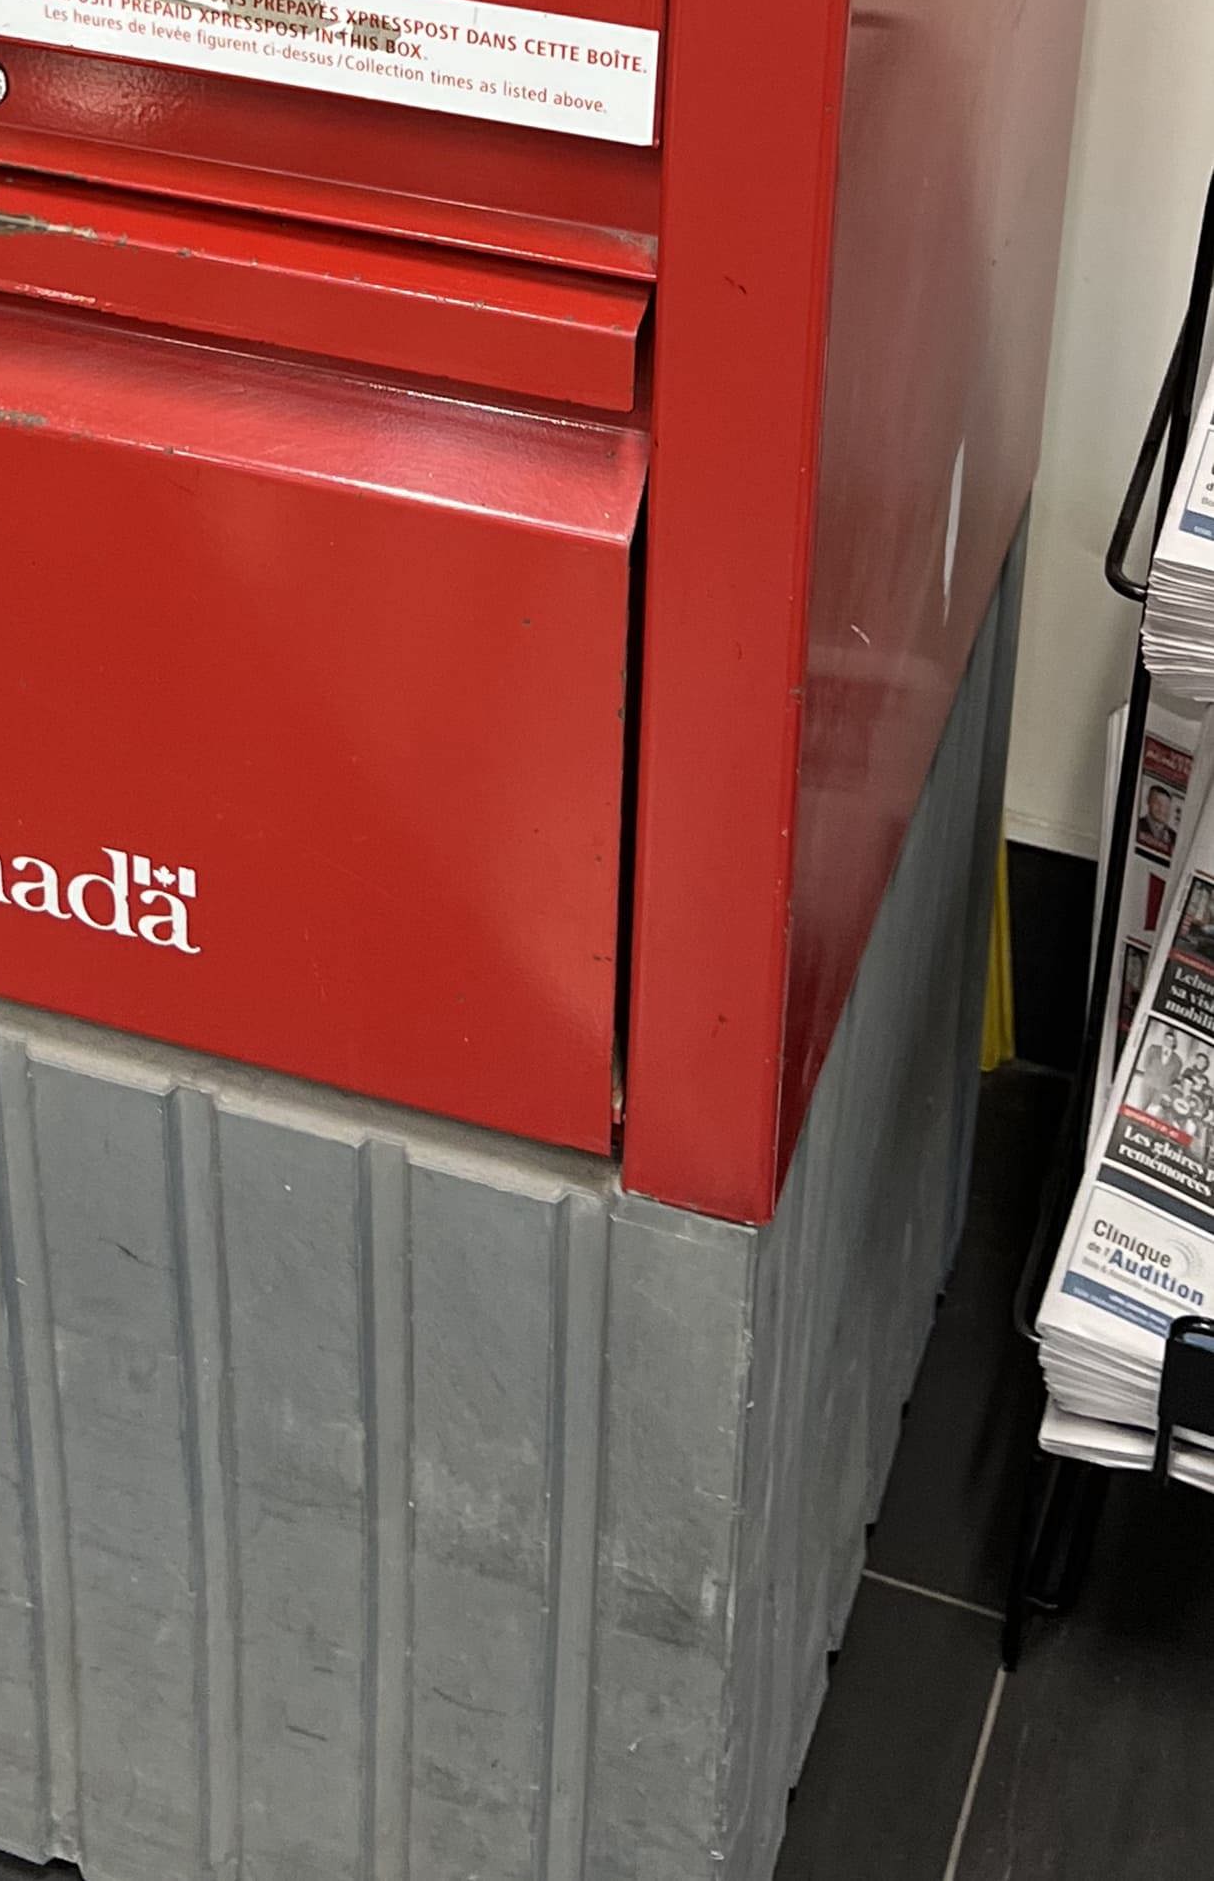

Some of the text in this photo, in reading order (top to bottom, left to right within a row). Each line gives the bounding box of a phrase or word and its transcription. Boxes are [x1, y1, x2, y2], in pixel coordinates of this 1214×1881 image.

[44, 3, 69, 23] Les
[72, 7, 124, 32] heures
[128, 16, 148, 34] de
[150, 20, 193, 44] levée
[195, 27, 259, 55] figurent
[430, 69, 475, 91] times
[478, 79, 497, 95] as
[502, 80, 548, 104] listed
[553, 92, 608, 114] above.
[197, 8, 310, 41] XPRESSPOST
[314, 26, 334, 45] IN
[336, 28, 379, 52] THIS
[385, 38, 429, 61] BOX.
[345, 8, 461, 41] XPRESSPOST
[466, 29, 518, 52] DANS
[524, 38, 581, 63] CETTE
[586, 46, 649, 74] BOÎTE.
[1124, 1124, 1151, 1148] Les
[1151, 1140, 1205, 1176] gloires
[1093, 1218, 1173, 1269] Clinique
